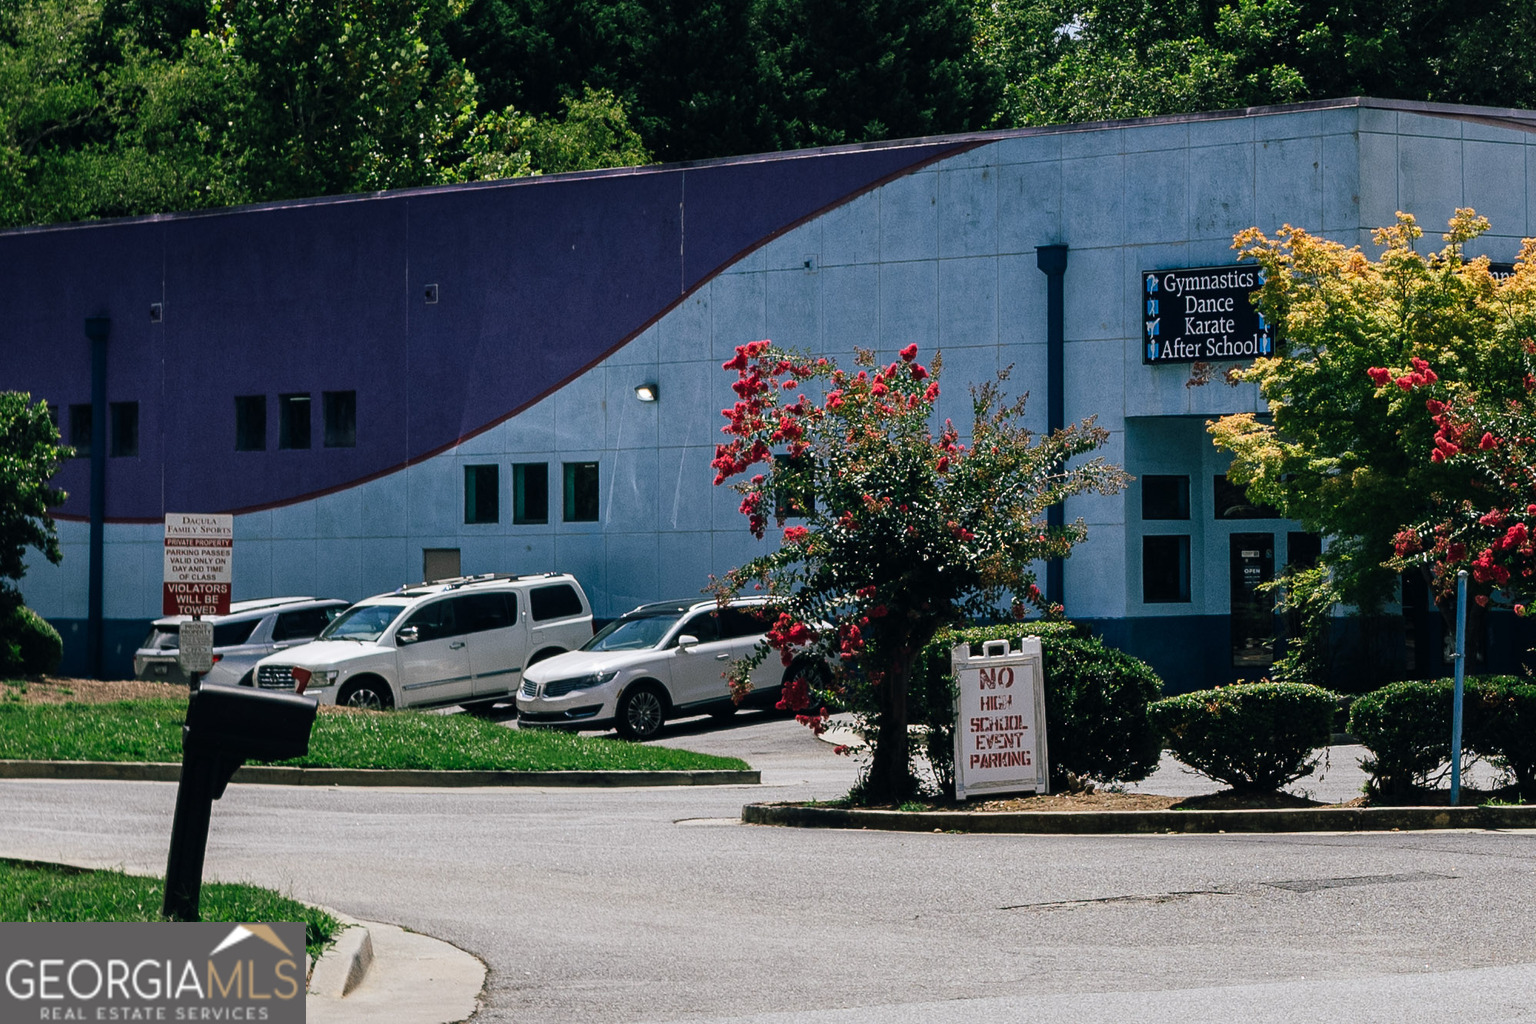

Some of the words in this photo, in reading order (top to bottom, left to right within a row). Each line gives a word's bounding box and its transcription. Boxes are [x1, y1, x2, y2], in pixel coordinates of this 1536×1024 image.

[1163, 270, 1254, 297] Gymnastics
[1185, 295, 1234, 314] Dance
[1185, 316, 1235, 335] Karate
[1160, 337, 1202, 359] After
[1206, 333, 1259, 357] School
[182, 516, 217, 525] DACULA
[167, 525, 198, 533] FAMILY
[200, 526, 232, 534] SPORTS
[167, 538, 194, 546] PRIVATE
[195, 539, 230, 547] PROPERTY
[215, 557, 226, 565] ON
[206, 565, 224, 573] TIME
[191, 573, 217, 581] CLASS
[167, 583, 228, 594] VIOLATORS
[175, 594, 202, 604] WILL
[204, 594, 219, 604] BE
[178, 605, 217, 614] TOWED
[979, 666, 1015, 690] NO
[980, 694, 1013, 712] HIGH
[970, 714, 1029, 733] SCHOOL
[975, 732, 1024, 750] EVENT
[970, 750, 1032, 769] PARKING
